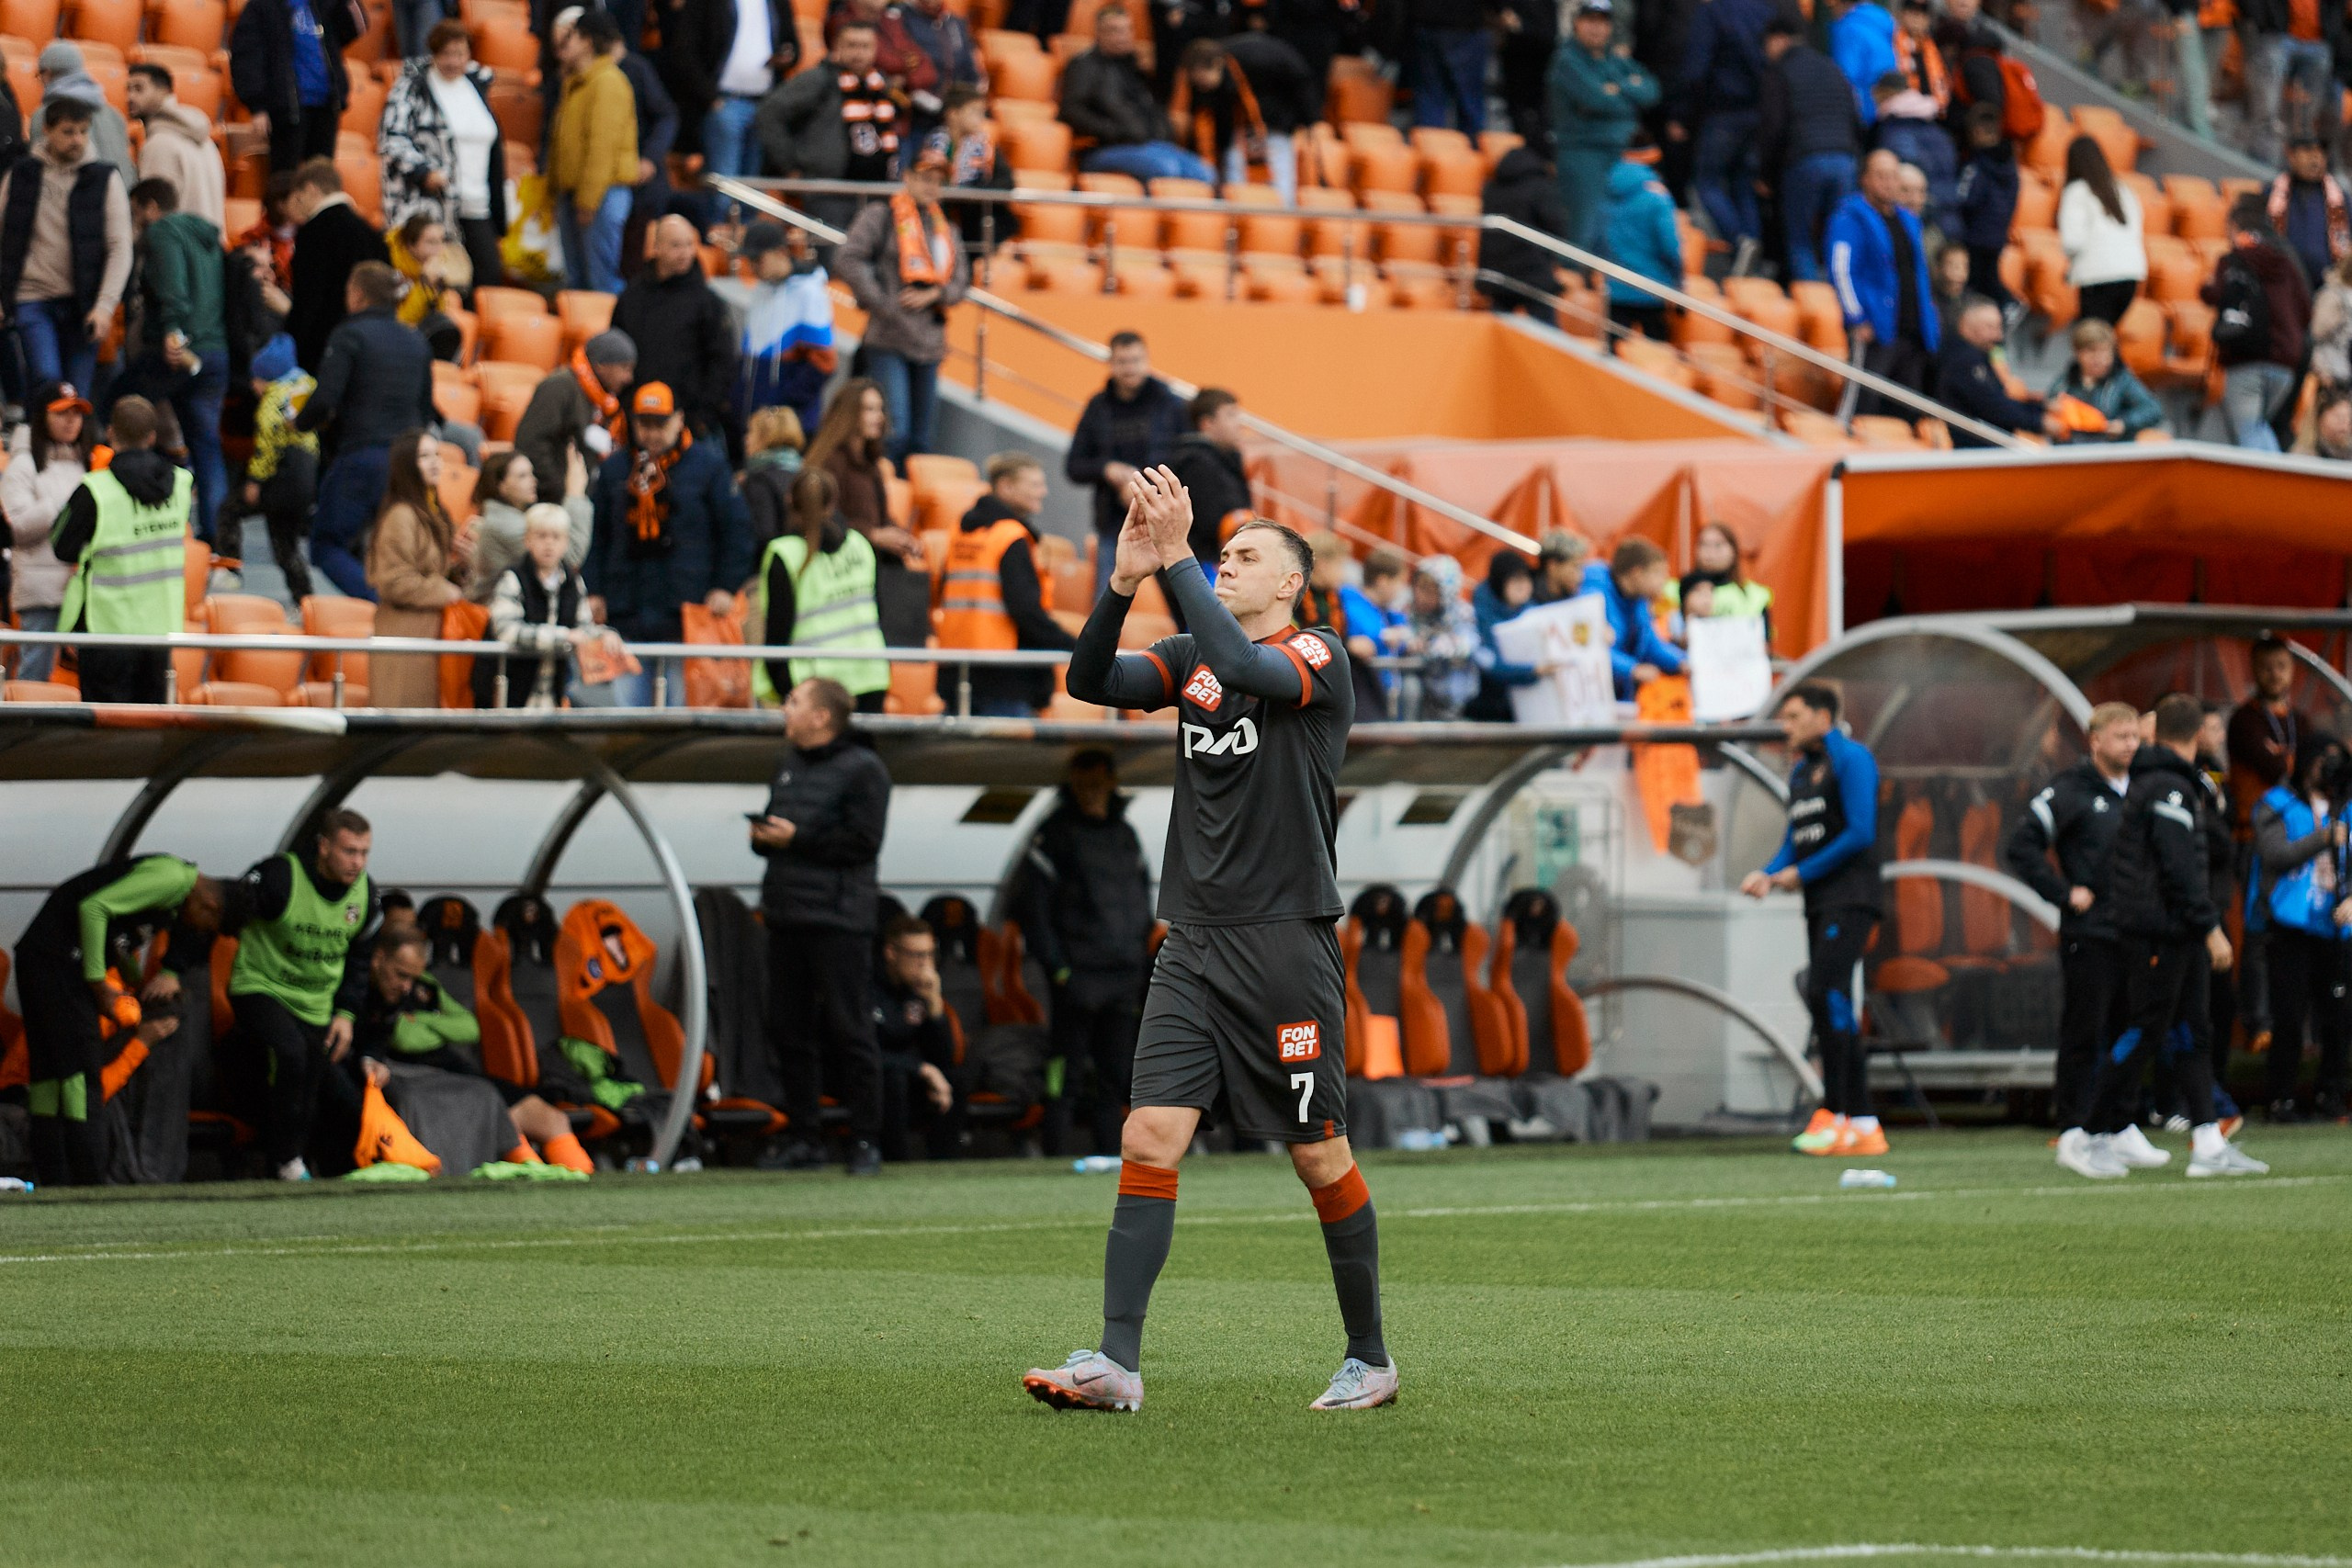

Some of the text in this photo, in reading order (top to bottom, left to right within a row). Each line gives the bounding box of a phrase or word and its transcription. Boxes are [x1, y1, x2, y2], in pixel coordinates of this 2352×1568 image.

[1291, 639, 1322, 666] BET
[1297, 635, 1329, 661] FON
[1185, 681, 1222, 705] BET
[1193, 670, 1223, 694] FON
[1281, 1024, 1317, 1043] FON
[1282, 1039, 1317, 1058] BET
[1290, 1071, 1315, 1123] 7
